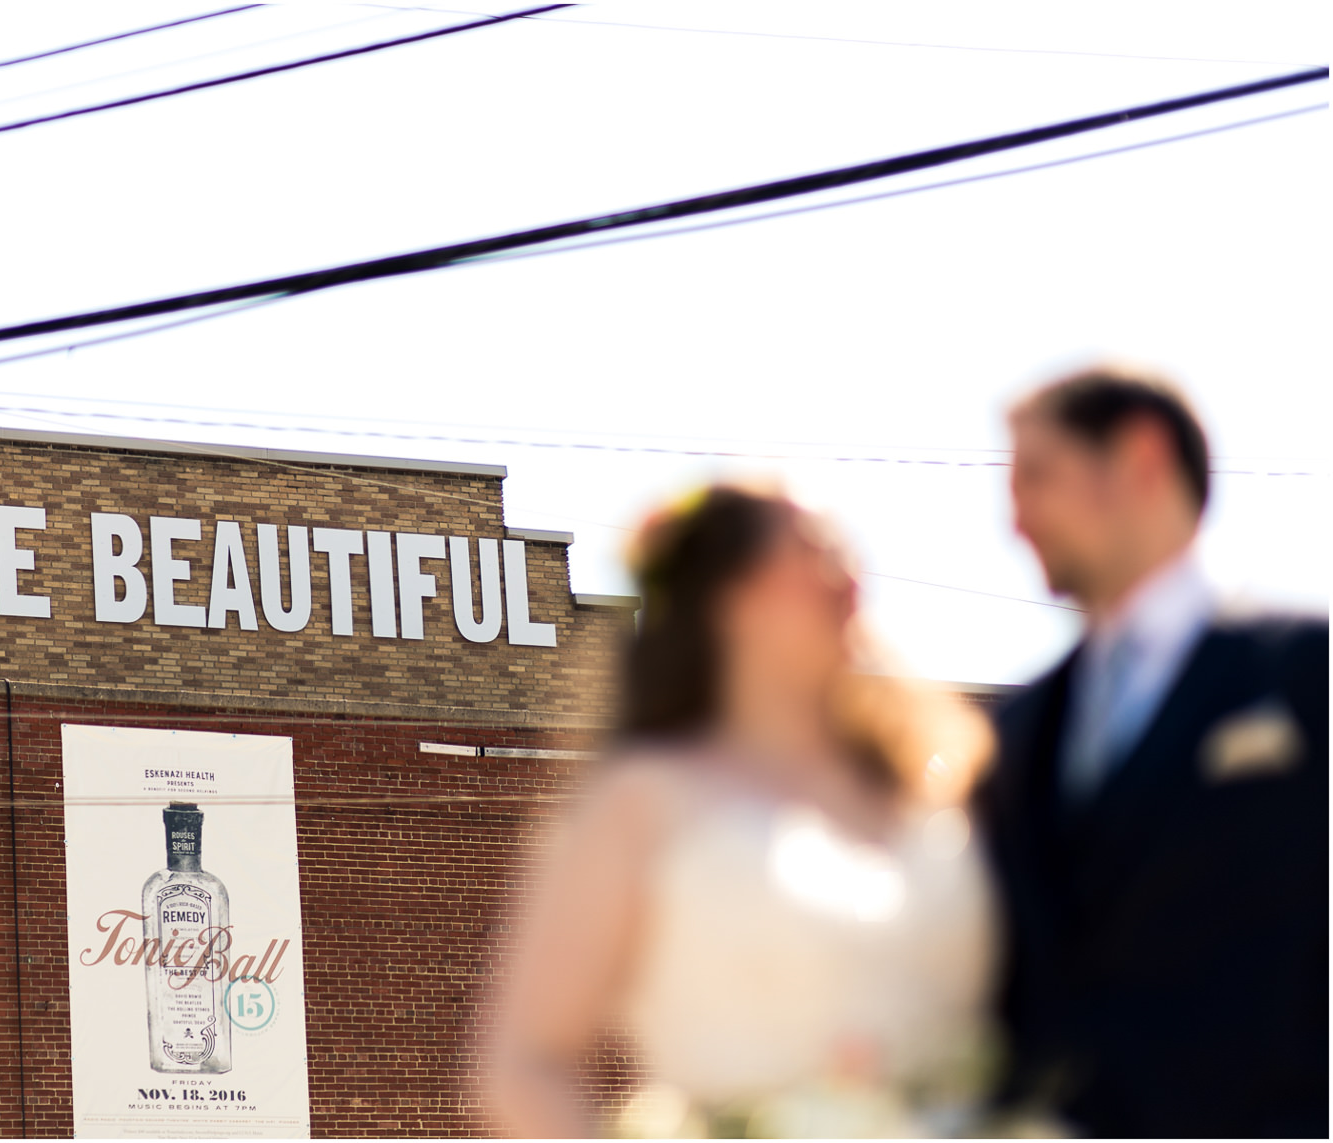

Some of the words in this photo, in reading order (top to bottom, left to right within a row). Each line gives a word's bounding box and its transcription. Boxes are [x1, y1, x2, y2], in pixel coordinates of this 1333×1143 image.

[90, 511, 557, 647] BEAUTIFUL
[144, 769, 183, 779] ESKENAZI
[185, 771, 215, 781] HEALTH
[172, 841, 196, 851] SPIRIT
[162, 910, 206, 924] REMEDY
[79, 909, 198, 967] Tonic
[168, 925, 290, 990] Ball
[237, 993, 264, 1018] 15
[138, 1088, 176, 1100] NOV.
[182, 1089, 205, 1103] 18,
[209, 1089, 246, 1101] 2016
